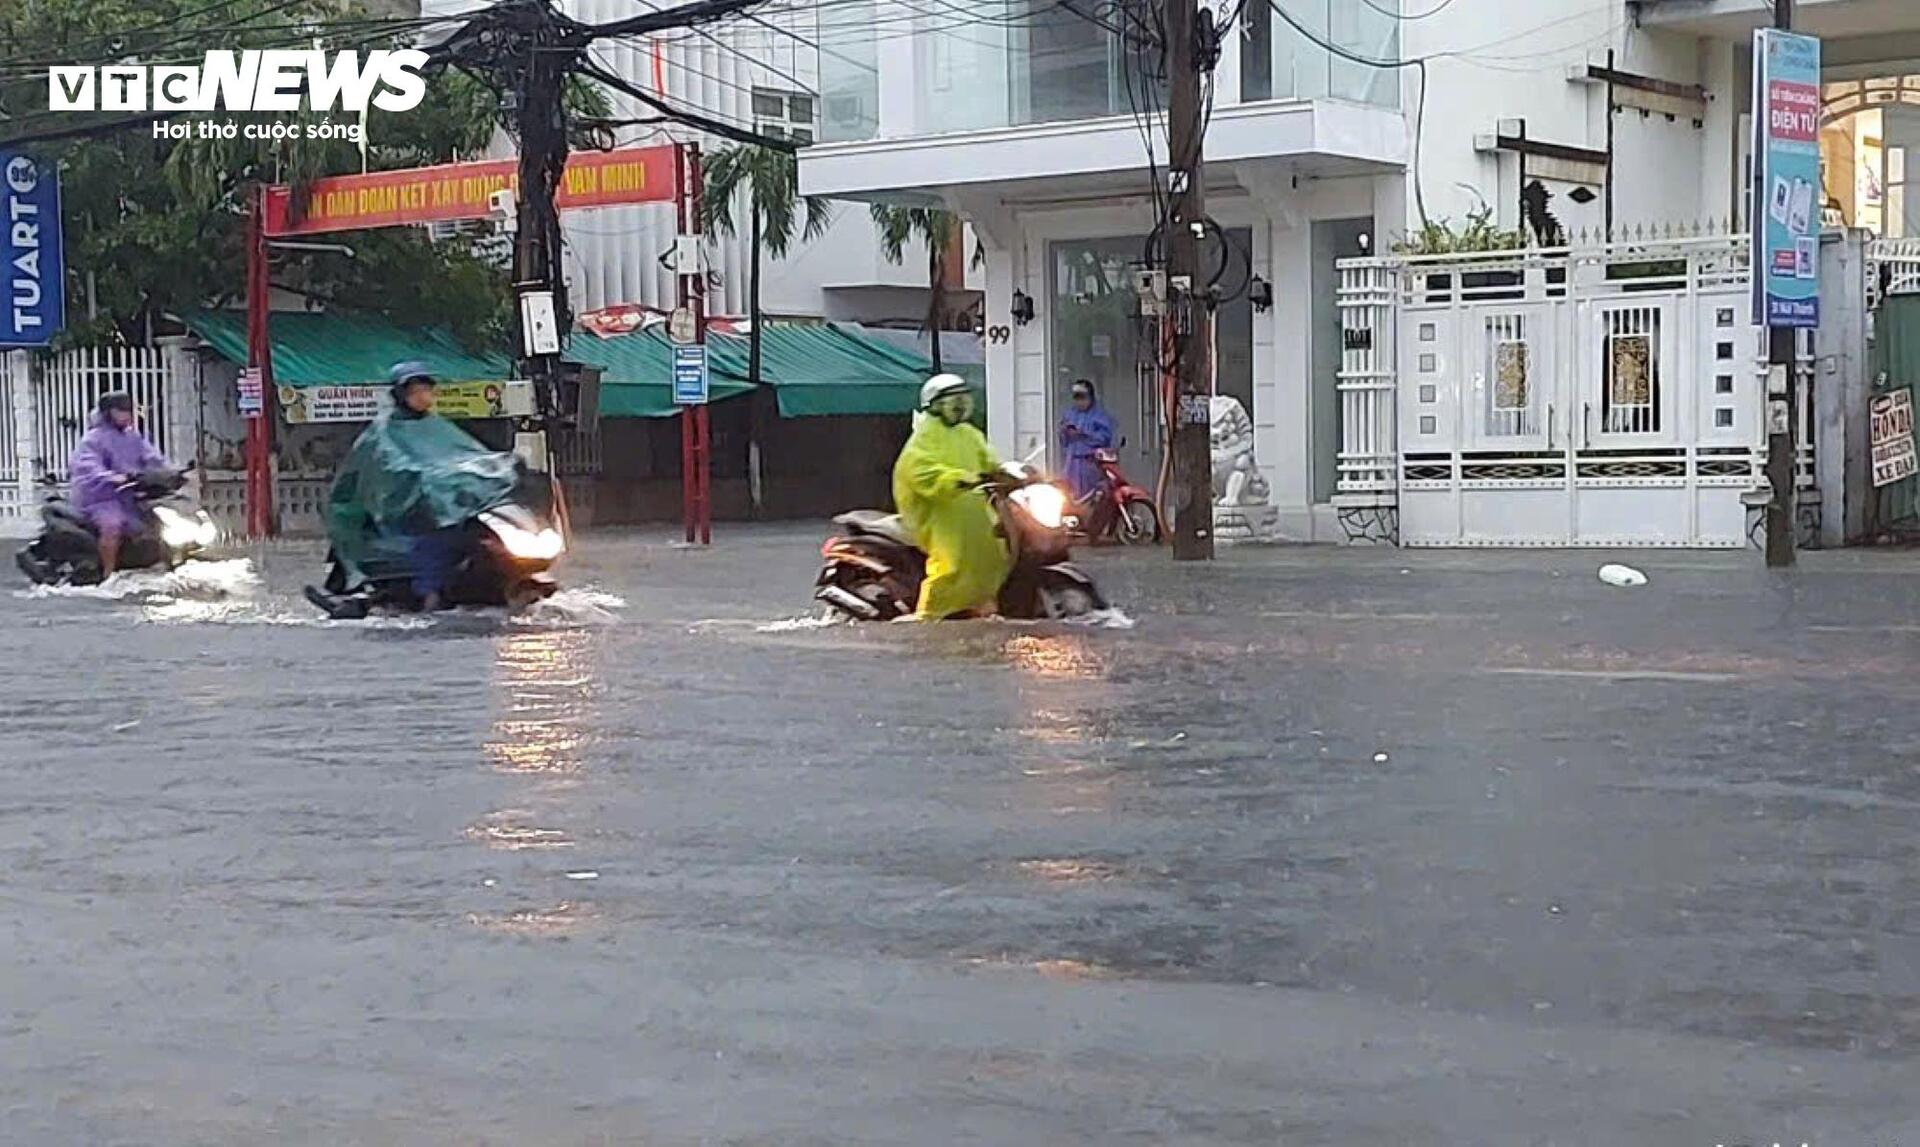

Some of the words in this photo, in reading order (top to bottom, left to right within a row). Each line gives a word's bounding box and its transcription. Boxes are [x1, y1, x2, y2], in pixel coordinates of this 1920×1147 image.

[10, 195, 42, 333] TUART
[989, 324, 1010, 345] 99
[1873, 406, 1912, 442] HONDA
